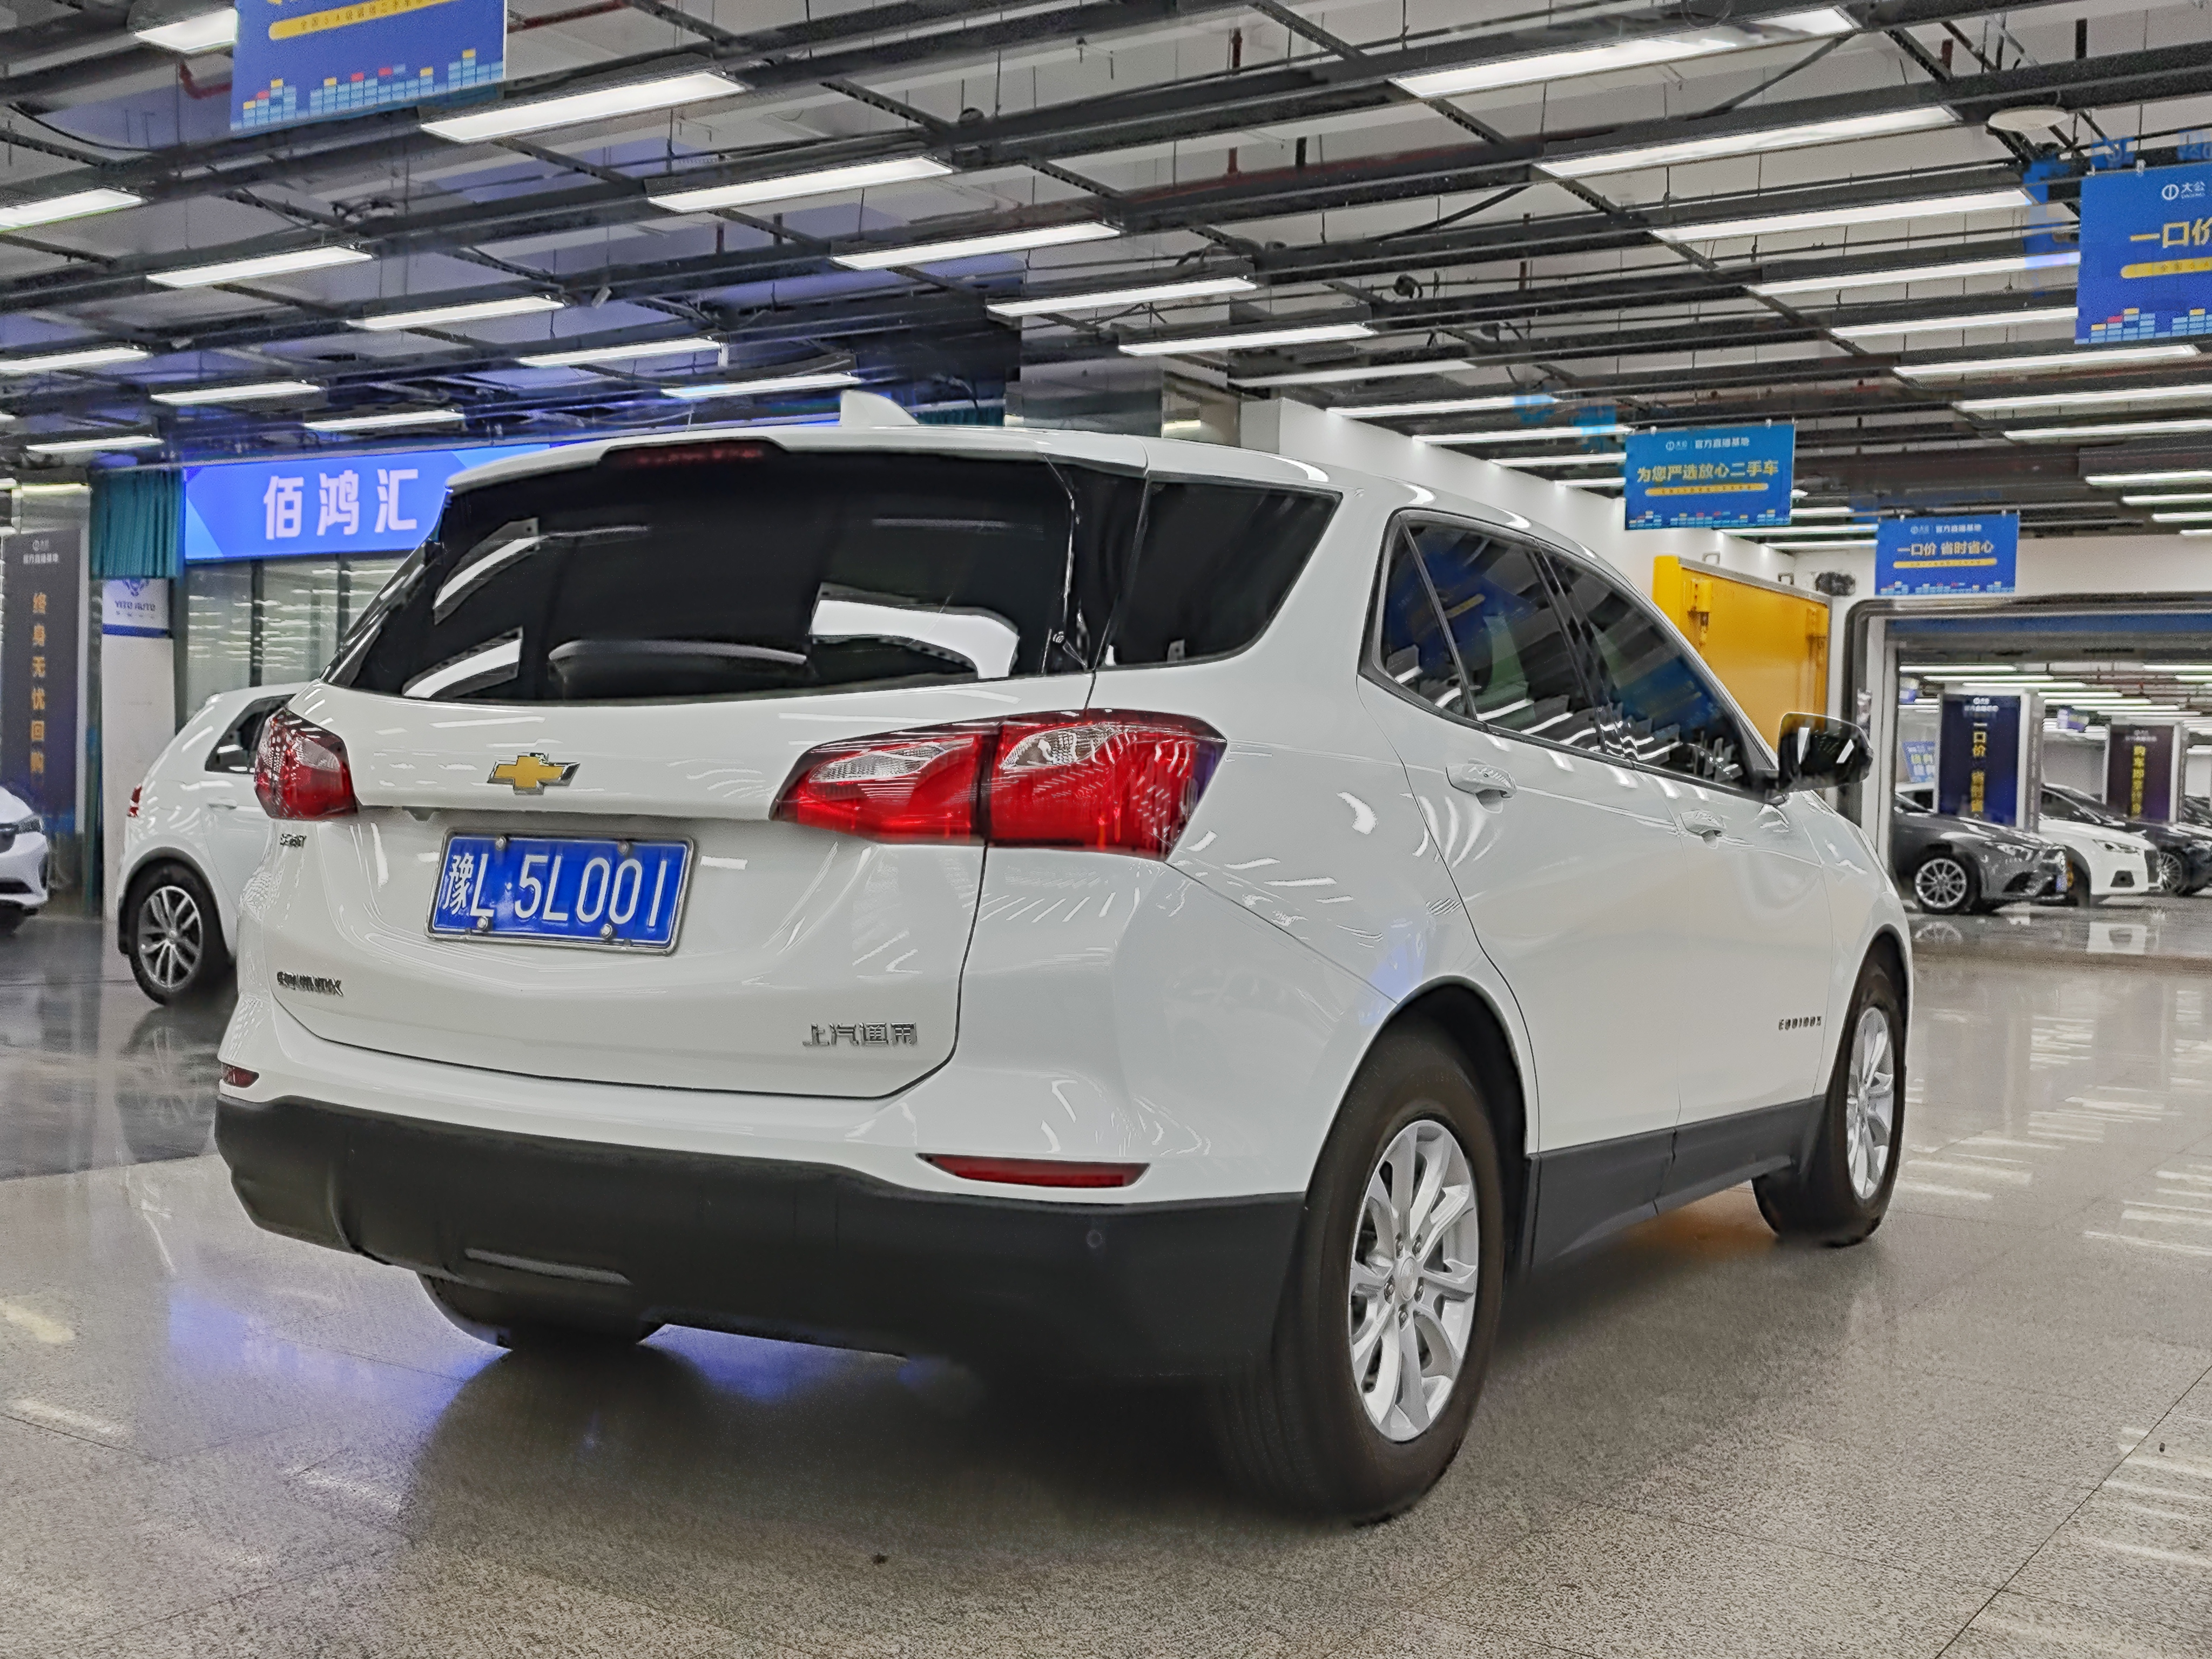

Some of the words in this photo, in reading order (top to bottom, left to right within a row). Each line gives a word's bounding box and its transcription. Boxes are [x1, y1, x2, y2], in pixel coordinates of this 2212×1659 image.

[1637, 460, 1779, 482] 为您严选放心二手车
[263, 468, 419, 540] 佰鸿汇
[1897, 542, 1937, 556] 一口价
[802, 1022, 918, 1046] 上汽通用
